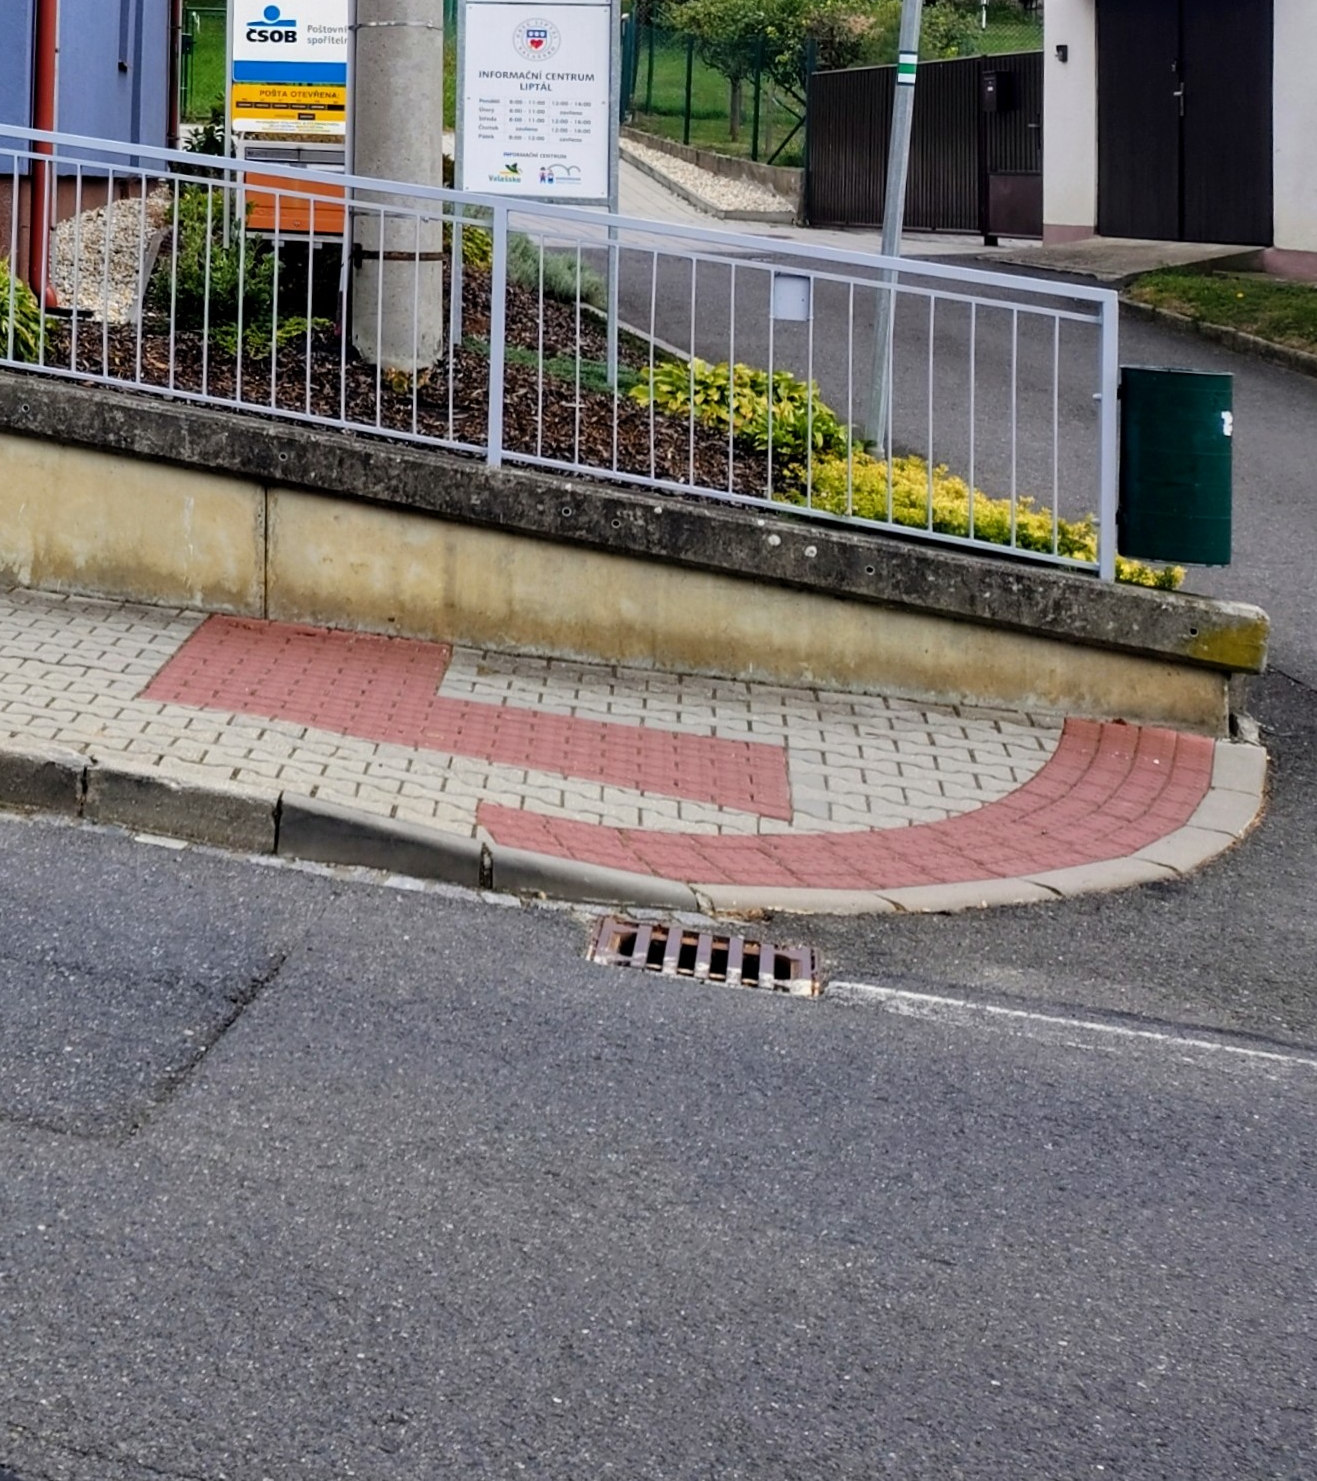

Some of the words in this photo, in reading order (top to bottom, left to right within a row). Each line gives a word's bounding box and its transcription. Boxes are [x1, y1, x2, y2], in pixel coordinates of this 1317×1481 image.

[246, 28, 297, 43] ČSOB
[479, 70, 542, 80] INFORMAČNÍ
[546, 73, 595, 81] CENTRUM
[519, 82, 552, 91] LIPTÁL
[259, 88, 288, 97] POŠTA
